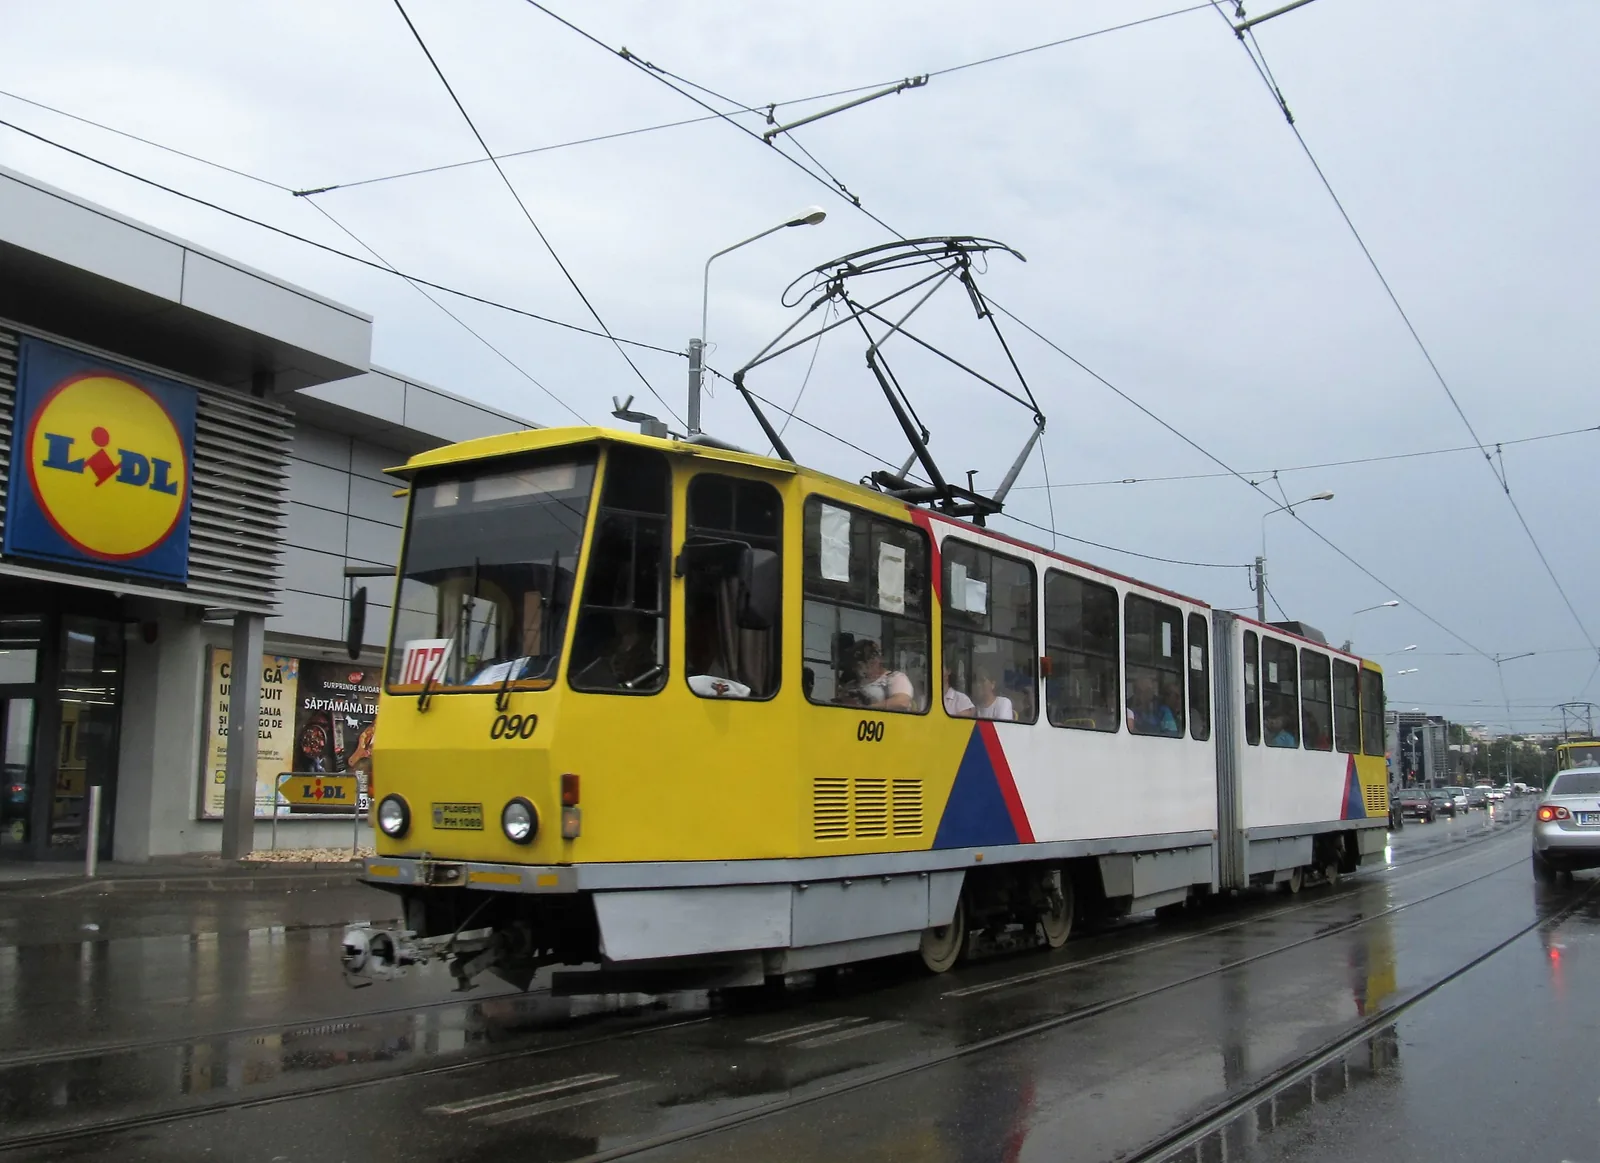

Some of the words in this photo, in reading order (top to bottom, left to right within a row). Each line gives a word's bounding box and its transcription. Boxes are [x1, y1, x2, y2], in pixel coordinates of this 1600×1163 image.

[404, 648, 445, 684] 102
[323, 681, 357, 692] SURPRINDE
[358, 685, 381, 694] SAVOAR
[304, 696, 363, 713] SĂPTĂMÂNA
[364, 704, 380, 715] IBE
[272, 720, 283, 729] DE
[490, 714, 538, 740] 090
[857, 720, 885, 742] 090
